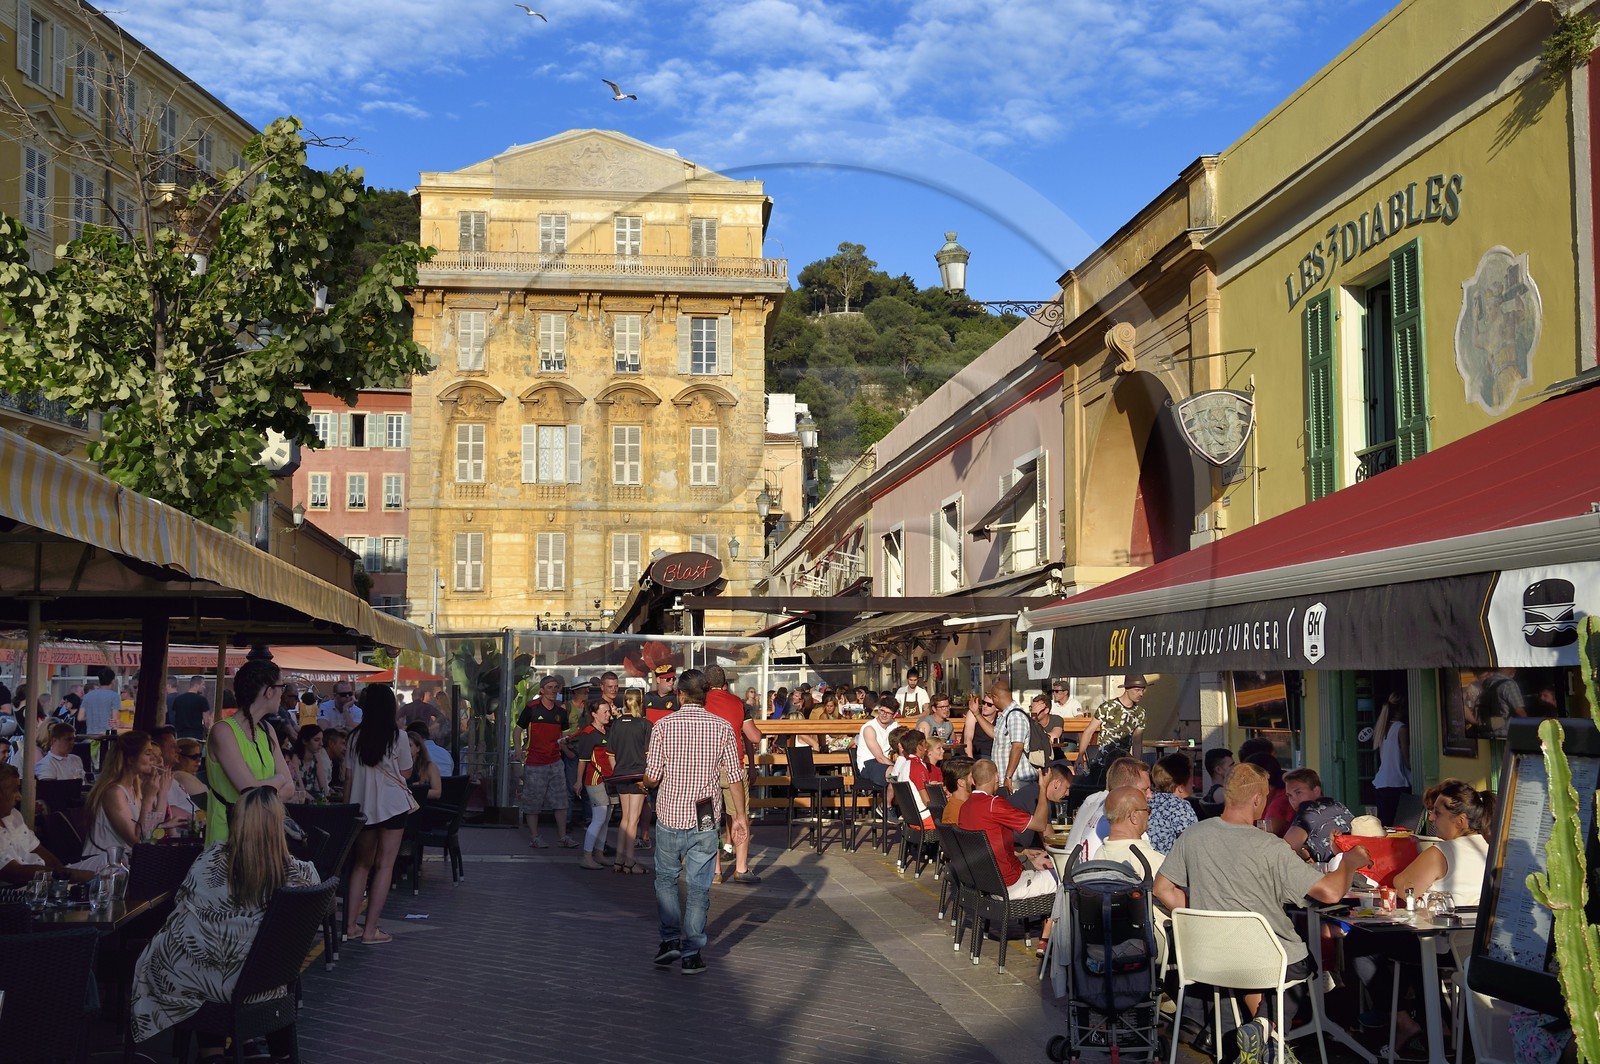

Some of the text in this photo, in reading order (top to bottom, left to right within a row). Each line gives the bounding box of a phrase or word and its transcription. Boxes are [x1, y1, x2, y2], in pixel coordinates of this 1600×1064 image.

[1285, 173, 1463, 313] LES 3 DIABLES
[662, 559, 713, 582] Blast
[1307, 611, 1323, 636] BH
[1109, 628, 1128, 667] BH
[1140, 632, 1157, 658] THE
[1160, 627, 1224, 656] FABULOUS
[291, 672, 341, 682] RESTAURANT
